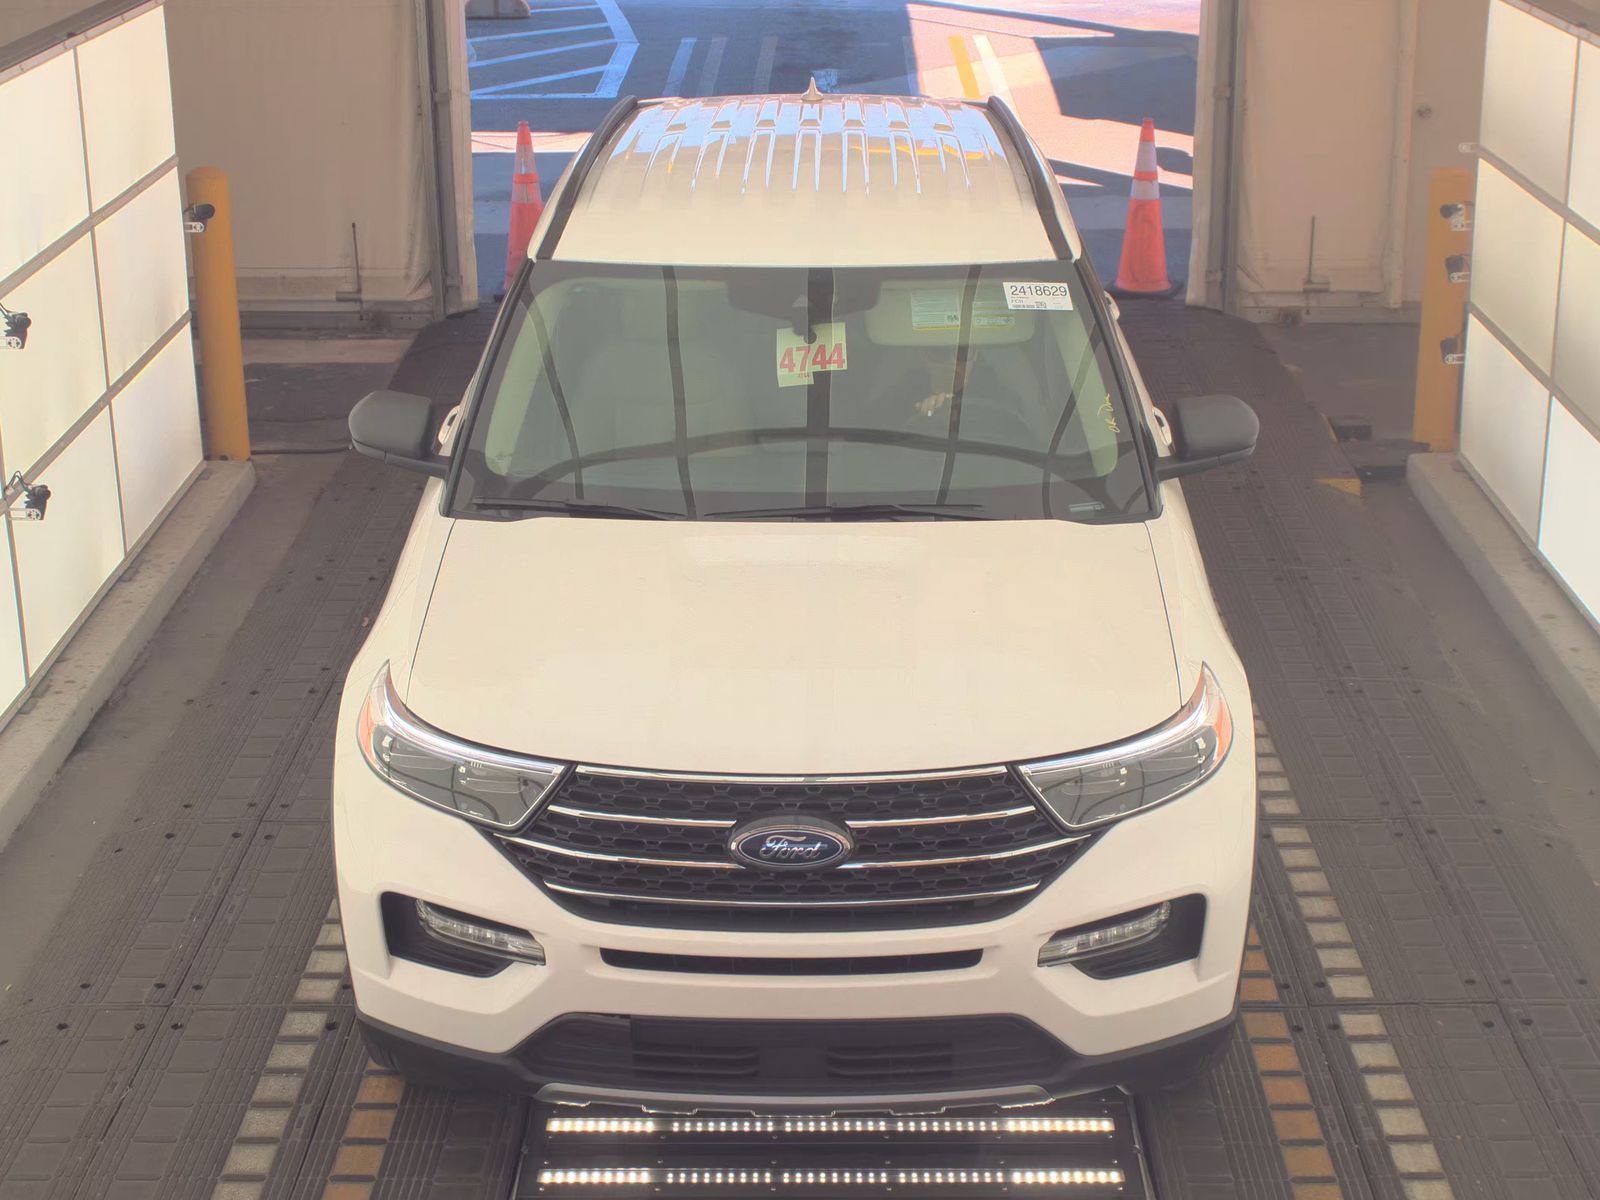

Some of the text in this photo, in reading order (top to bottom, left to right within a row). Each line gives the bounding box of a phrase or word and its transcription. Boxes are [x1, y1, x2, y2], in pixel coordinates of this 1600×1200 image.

[1010, 285, 1067, 296] 2418629
[779, 343, 844, 373] 4744
[759, 835, 823, 859] Ford
